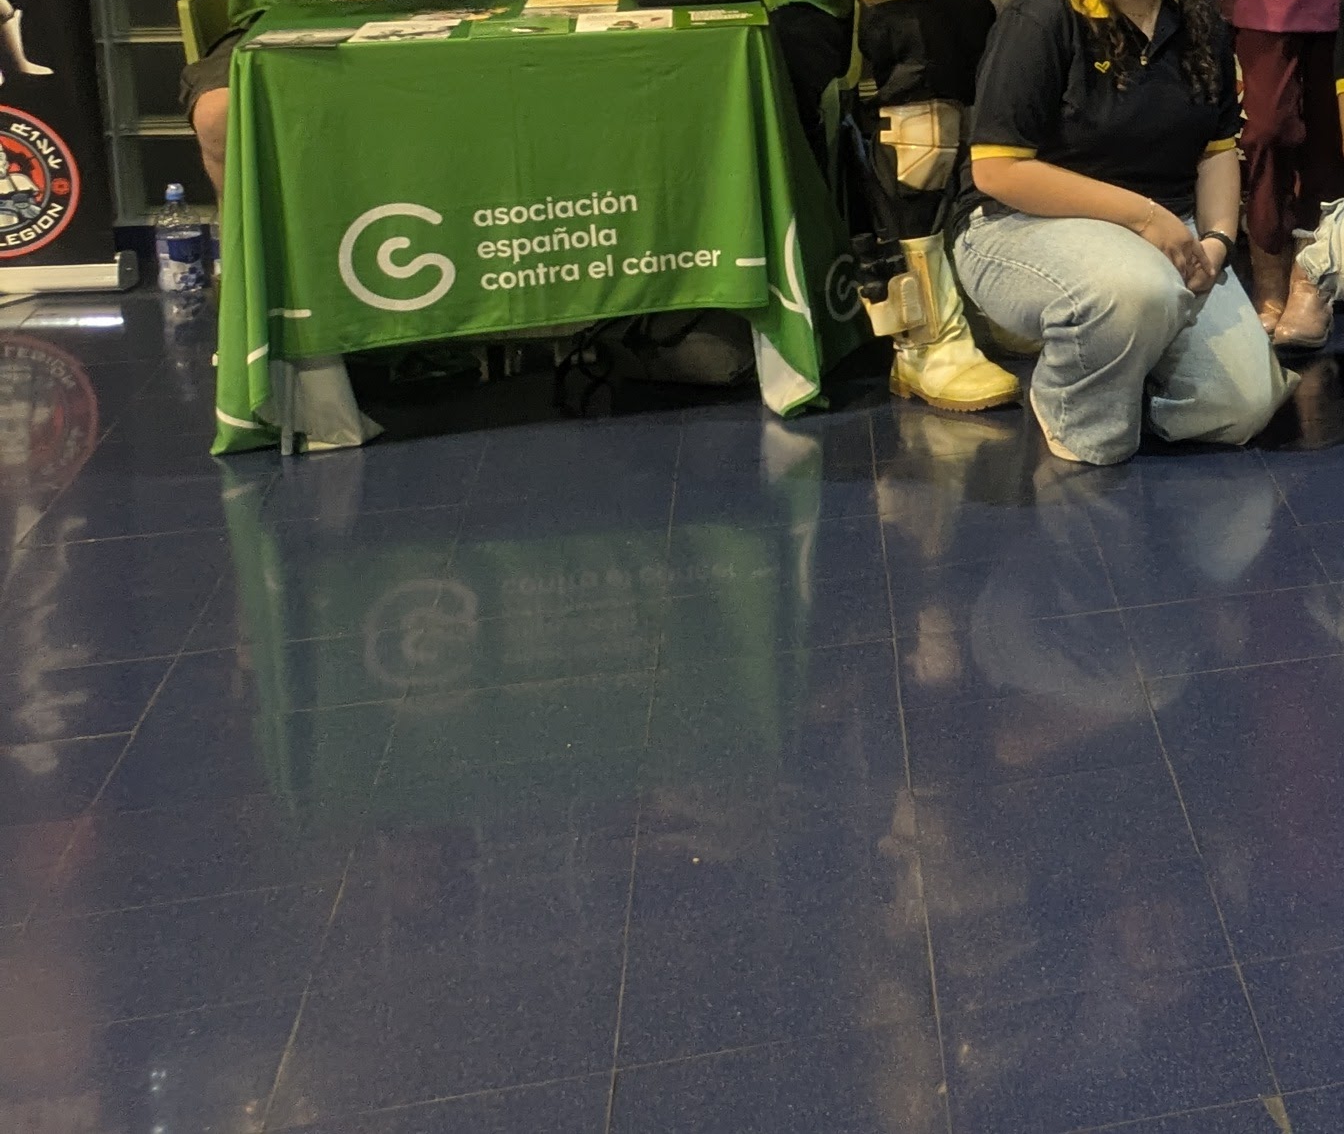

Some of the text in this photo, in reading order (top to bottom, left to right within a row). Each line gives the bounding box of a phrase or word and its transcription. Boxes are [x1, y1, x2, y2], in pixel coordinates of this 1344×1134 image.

[0, 202, 64, 246] EGION
[473, 191, 638, 227] asociación
[477, 224, 618, 265] española
[481, 249, 722, 291] contra el cáncer
